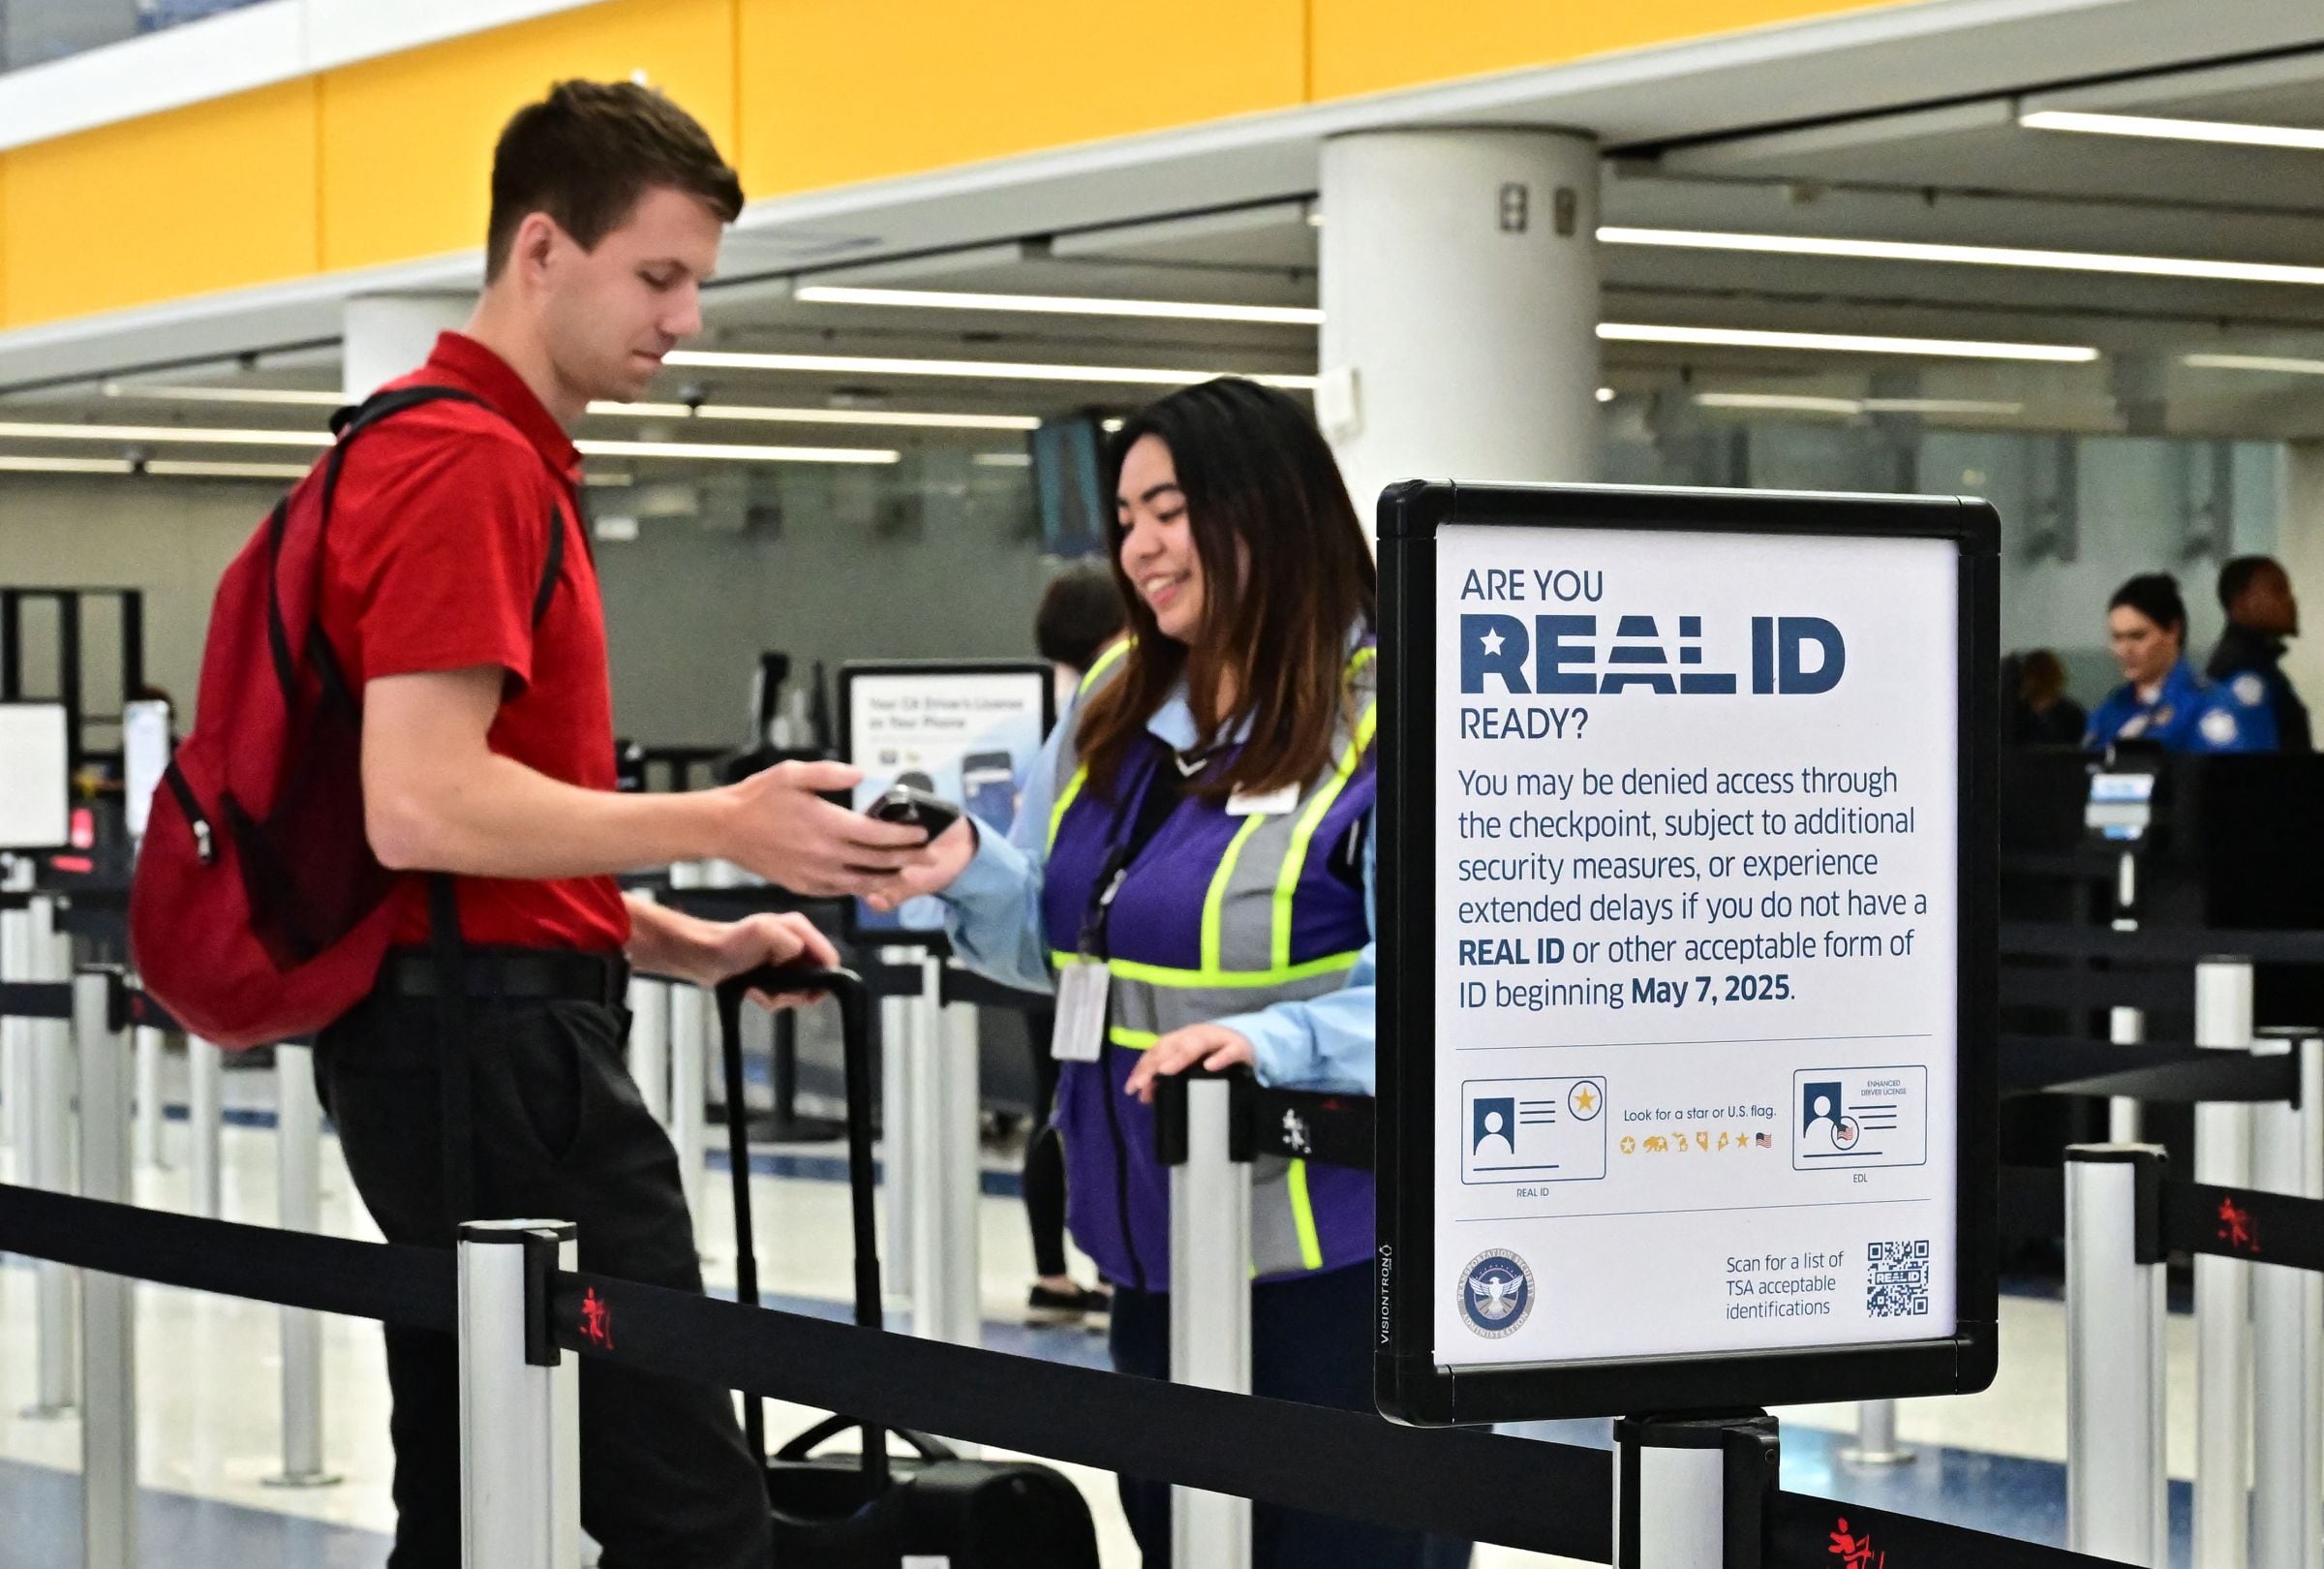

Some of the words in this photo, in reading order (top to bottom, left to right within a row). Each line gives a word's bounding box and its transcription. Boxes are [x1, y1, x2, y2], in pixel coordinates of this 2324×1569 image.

[1460, 569, 1525, 601] ARE
[1533, 569, 1605, 602] YOU
[1459, 613, 1737, 695] REAL
[1751, 616, 1846, 695] ID
[1460, 707, 1589, 740] READY?
[1457, 769, 1508, 796] You
[1516, 774, 1575, 801] may
[1582, 767, 1614, 796] be
[1621, 766, 1708, 795] denied
[1716, 772, 1794, 795] access
[1800, 765, 1898, 798] through
[1457, 810, 1502, 840] the
[1509, 809, 1657, 843] checkpoint,
[1665, 808, 1755, 841] subject
[1760, 809, 1787, 836] to
[1793, 806, 1914, 835] additional
[1458, 851, 1565, 885] security
[1573, 856, 1701, 882] measures,
[1708, 855, 1736, 878] or
[1743, 847, 1879, 881] experience
[1458, 893, 1581, 924] extended
[1589, 892, 1673, 925] delays
[1682, 891, 1699, 920] if
[1705, 897, 1753, 924] you
[1760, 890, 1792, 918] do
[1800, 890, 1841, 917] not
[1848, 888, 1907, 916] have
[1913, 893, 1927, 915] a
[1458, 938, 1531, 967] REAL
[1537, 938, 1565, 965] ID
[1573, 941, 1601, 965] or
[1607, 934, 1677, 964] other
[1684, 931, 1817, 965] acceptable
[1822, 930, 1882, 958] form
[1889, 928, 1915, 957] of
[1460, 981, 1486, 1008] ID
[1496, 977, 1625, 1012] beginning
[1632, 976, 1689, 1008] May
[1695, 975, 1718, 1006] 7,
[1725, 973, 1795, 1001] 2025.
[1867, 1079, 1901, 1088] ENHANCED
[1623, 1108, 1652, 1122] Look
[1655, 1107, 1672, 1121] for
[1674, 1110, 1684, 1120] a
[1686, 1107, 1709, 1120] star
[1712, 1107, 1725, 1119] or
[1728, 1105, 1749, 1119] U.S.
[1750, 1104, 1777, 1120] flag.
[1516, 1187, 1538, 1198] REAL
[1541, 1187, 1549, 1197] ID
[1852, 1173, 1868, 1184] EDL
[1727, 1256, 1760, 1274] Scan
[1765, 1254, 1788, 1272] for
[1790, 1256, 1799, 1270] a
[1803, 1251, 1825, 1270] list
[1828, 1250, 1845, 1269] of
[1380, 1257, 1390, 1344] VISIONTRON
[1726, 1278, 1755, 1297] TSA
[1758, 1275, 1837, 1297] acceptable
[1726, 1299, 1830, 1320] identifications
